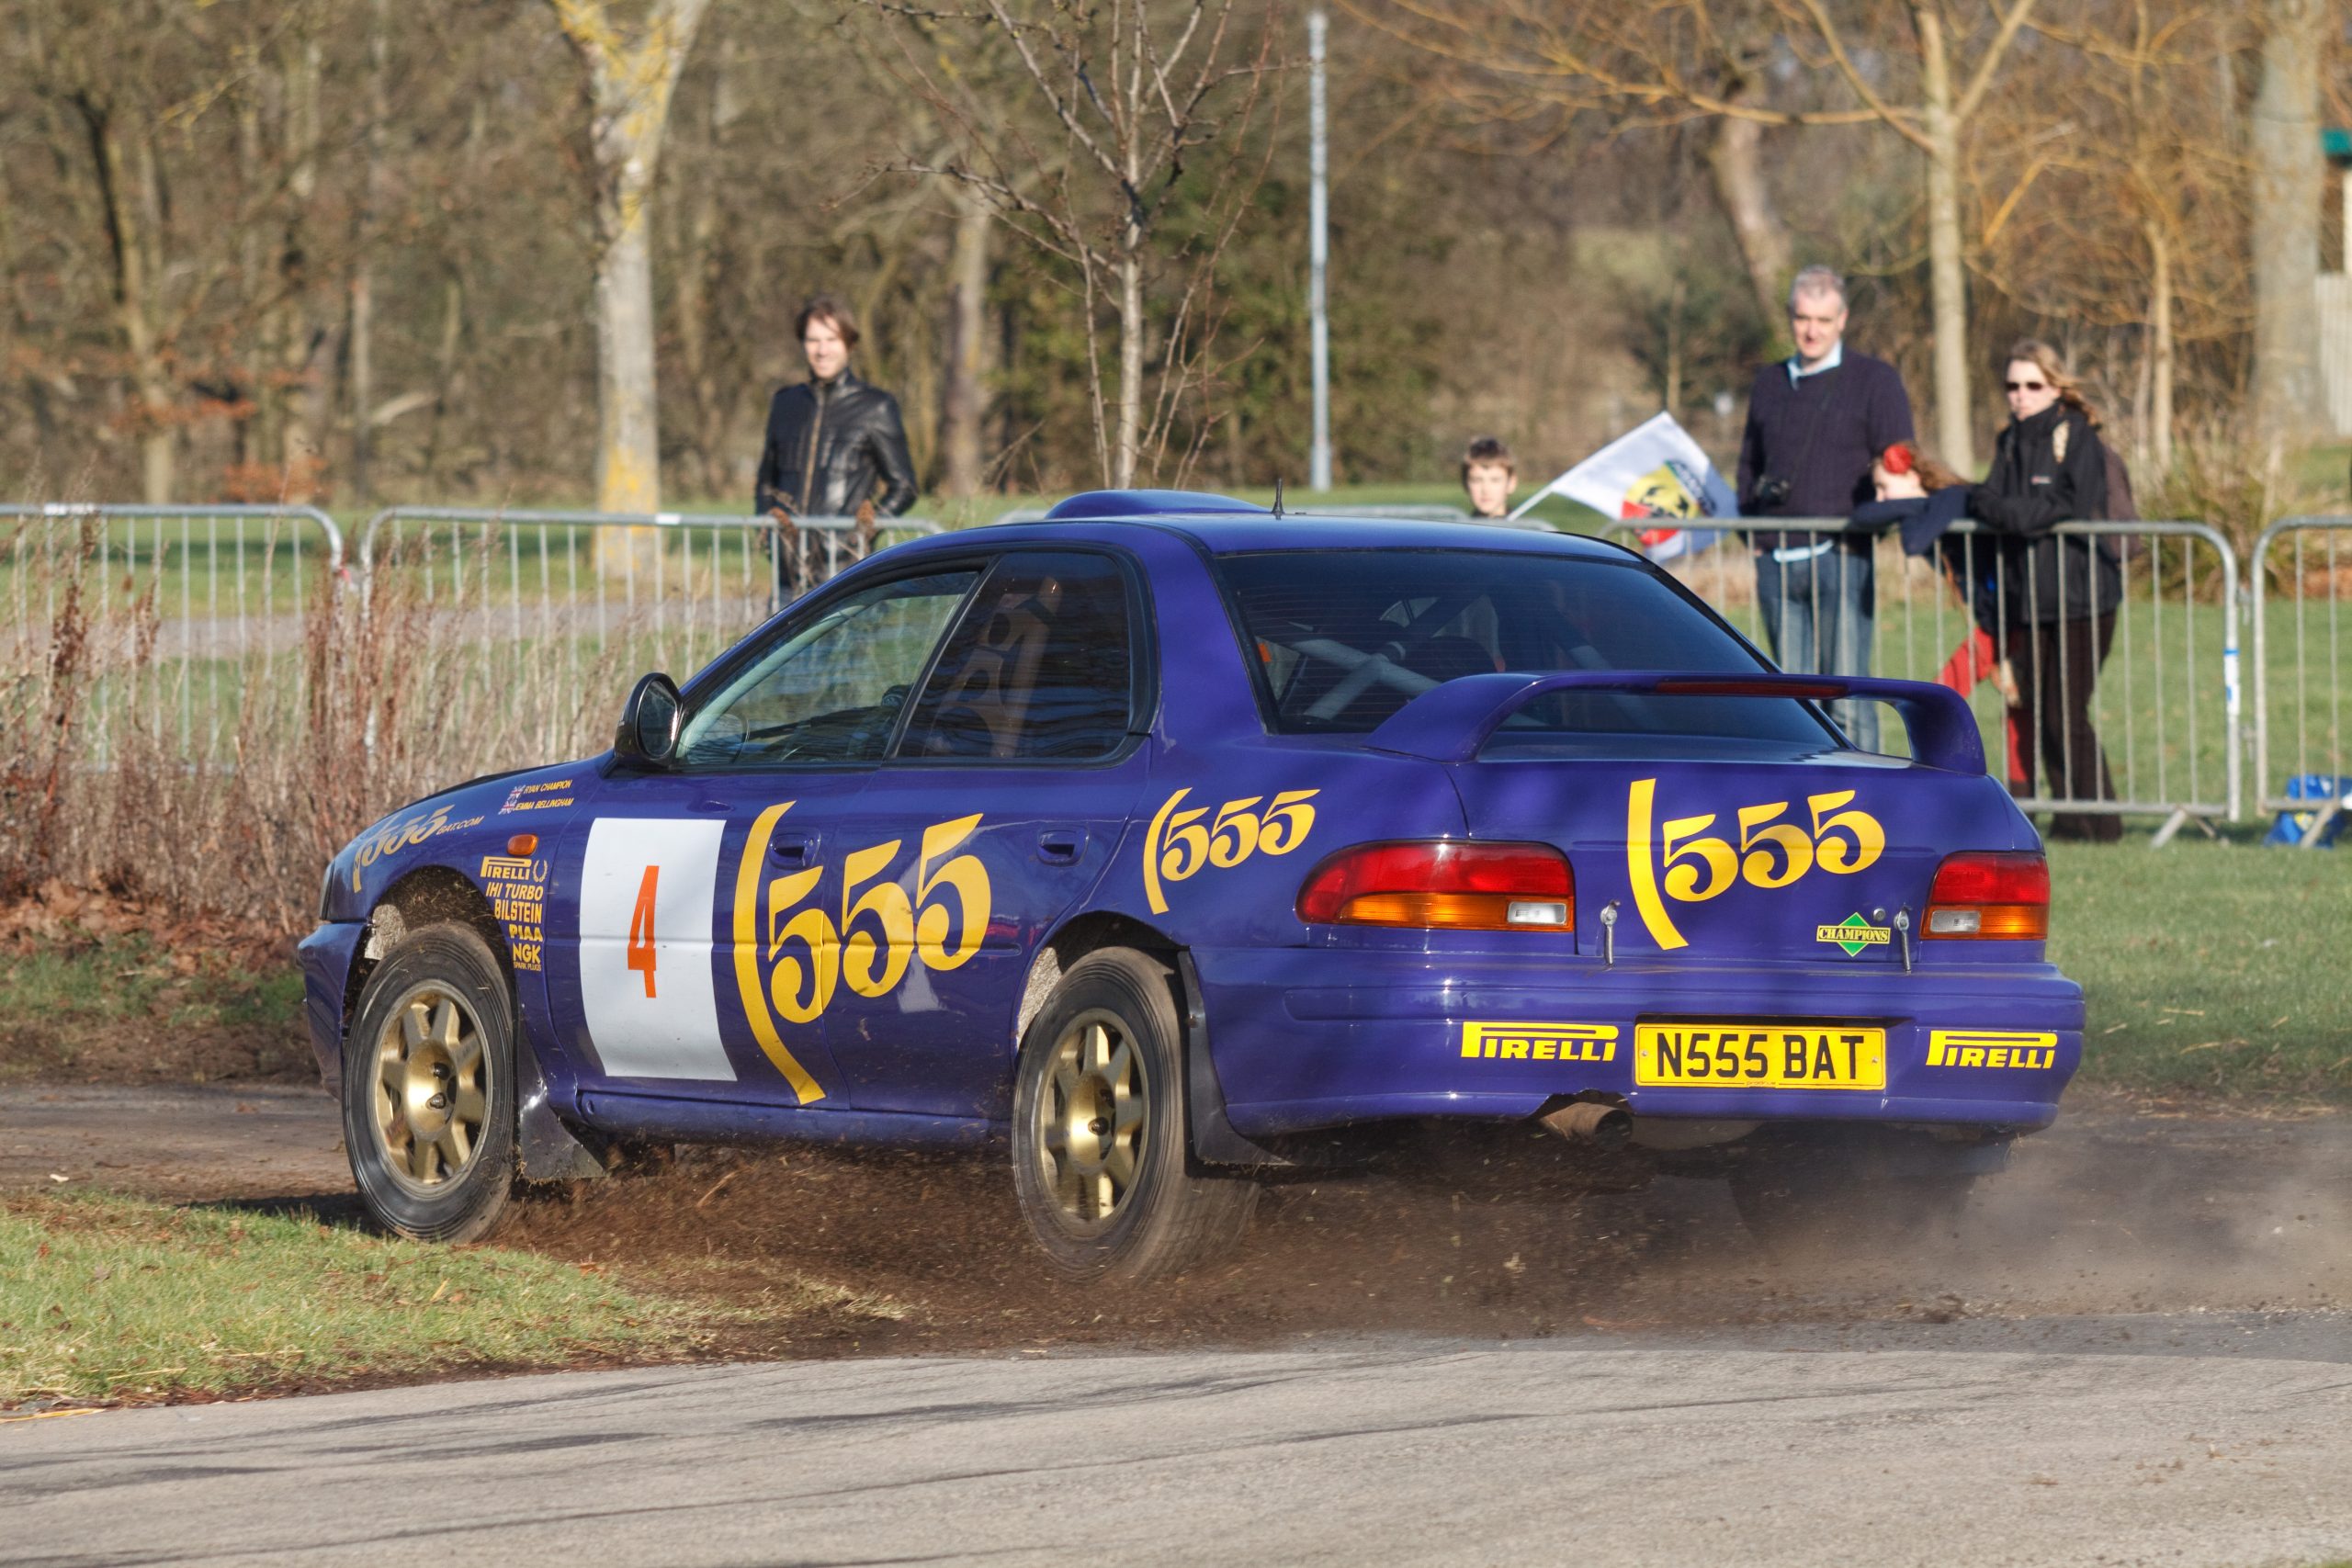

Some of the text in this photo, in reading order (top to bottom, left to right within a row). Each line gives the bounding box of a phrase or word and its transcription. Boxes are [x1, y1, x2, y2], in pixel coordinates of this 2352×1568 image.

[541, 779, 572, 792] CHAMPION
[535, 798, 574, 808] BELLINGHAM
[480, 856, 532, 880] PIRELLI
[486, 882, 544, 901] IHI TURBO
[494, 899, 543, 924] BILSTEIN
[509, 923, 544, 942] PIAA
[628, 865, 660, 998] 4
[1819, 928, 1888, 942] CHAMPIONS
[513, 942, 541, 964] NGK
[1461, 1021, 1619, 1062] PIRELLI
[1926, 1030, 2058, 1069] PIRELLI
[1657, 1032, 1864, 1080] N555 BAT
